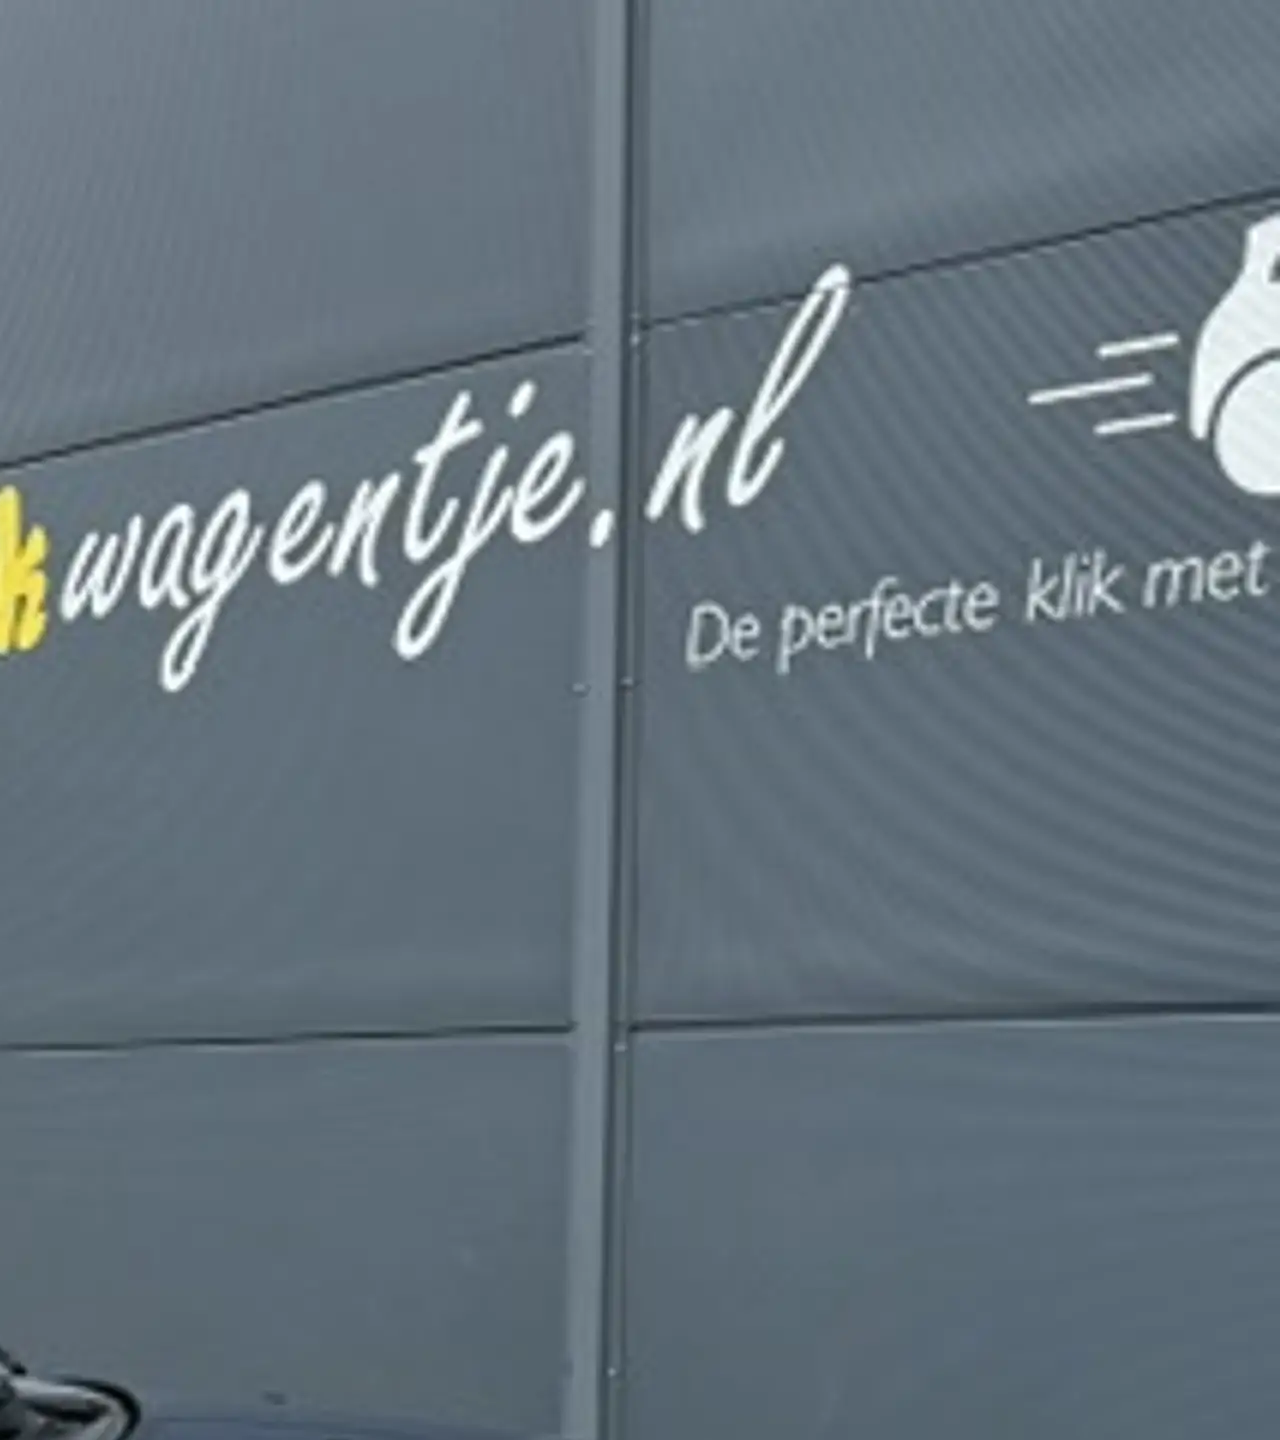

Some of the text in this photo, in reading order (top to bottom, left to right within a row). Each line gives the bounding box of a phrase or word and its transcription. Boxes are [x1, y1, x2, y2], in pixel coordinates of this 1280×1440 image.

[685, 538, 1271, 676] De perfecte klik met
